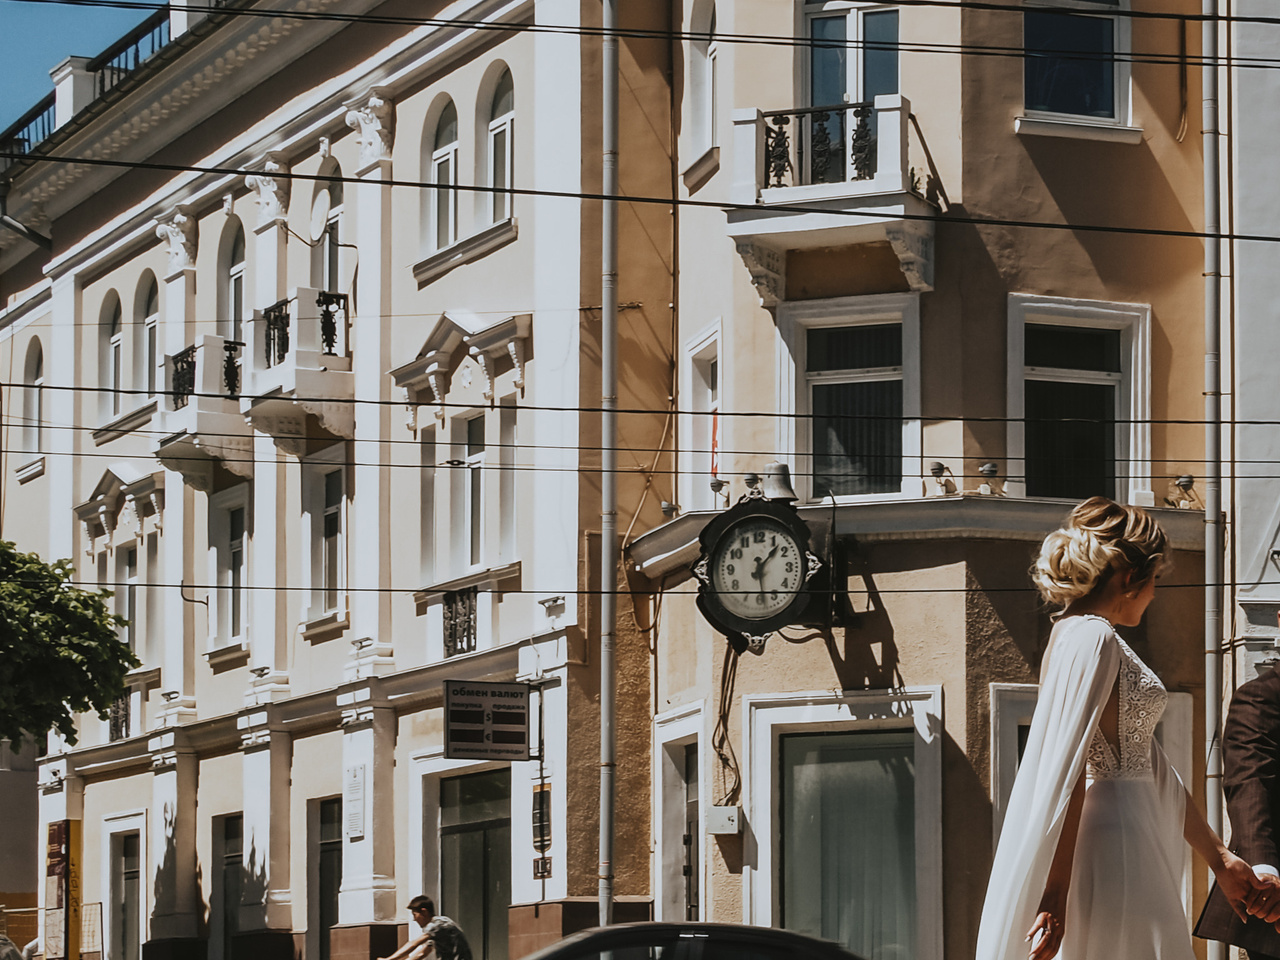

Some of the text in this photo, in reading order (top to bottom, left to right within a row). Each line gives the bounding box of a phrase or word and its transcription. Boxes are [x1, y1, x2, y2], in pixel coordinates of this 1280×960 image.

[741, 536, 750, 548] 11
[753, 531, 766, 544] 12
[771, 535, 776, 548] 1
[730, 548, 743, 560] 10
[781, 546, 788, 558] 2
[726, 564, 735, 576] 9
[785, 562, 794, 573] 3
[731, 579, 739, 591] 8
[781, 577, 788, 589] 4
[755, 593, 764, 605] 6
[452, 687, 525, 699] обмен валют
[451, 702, 483, 710] покупка
[492, 703, 526, 711] продажа
[485, 712, 491, 722] $
[485, 733, 491, 741] €
